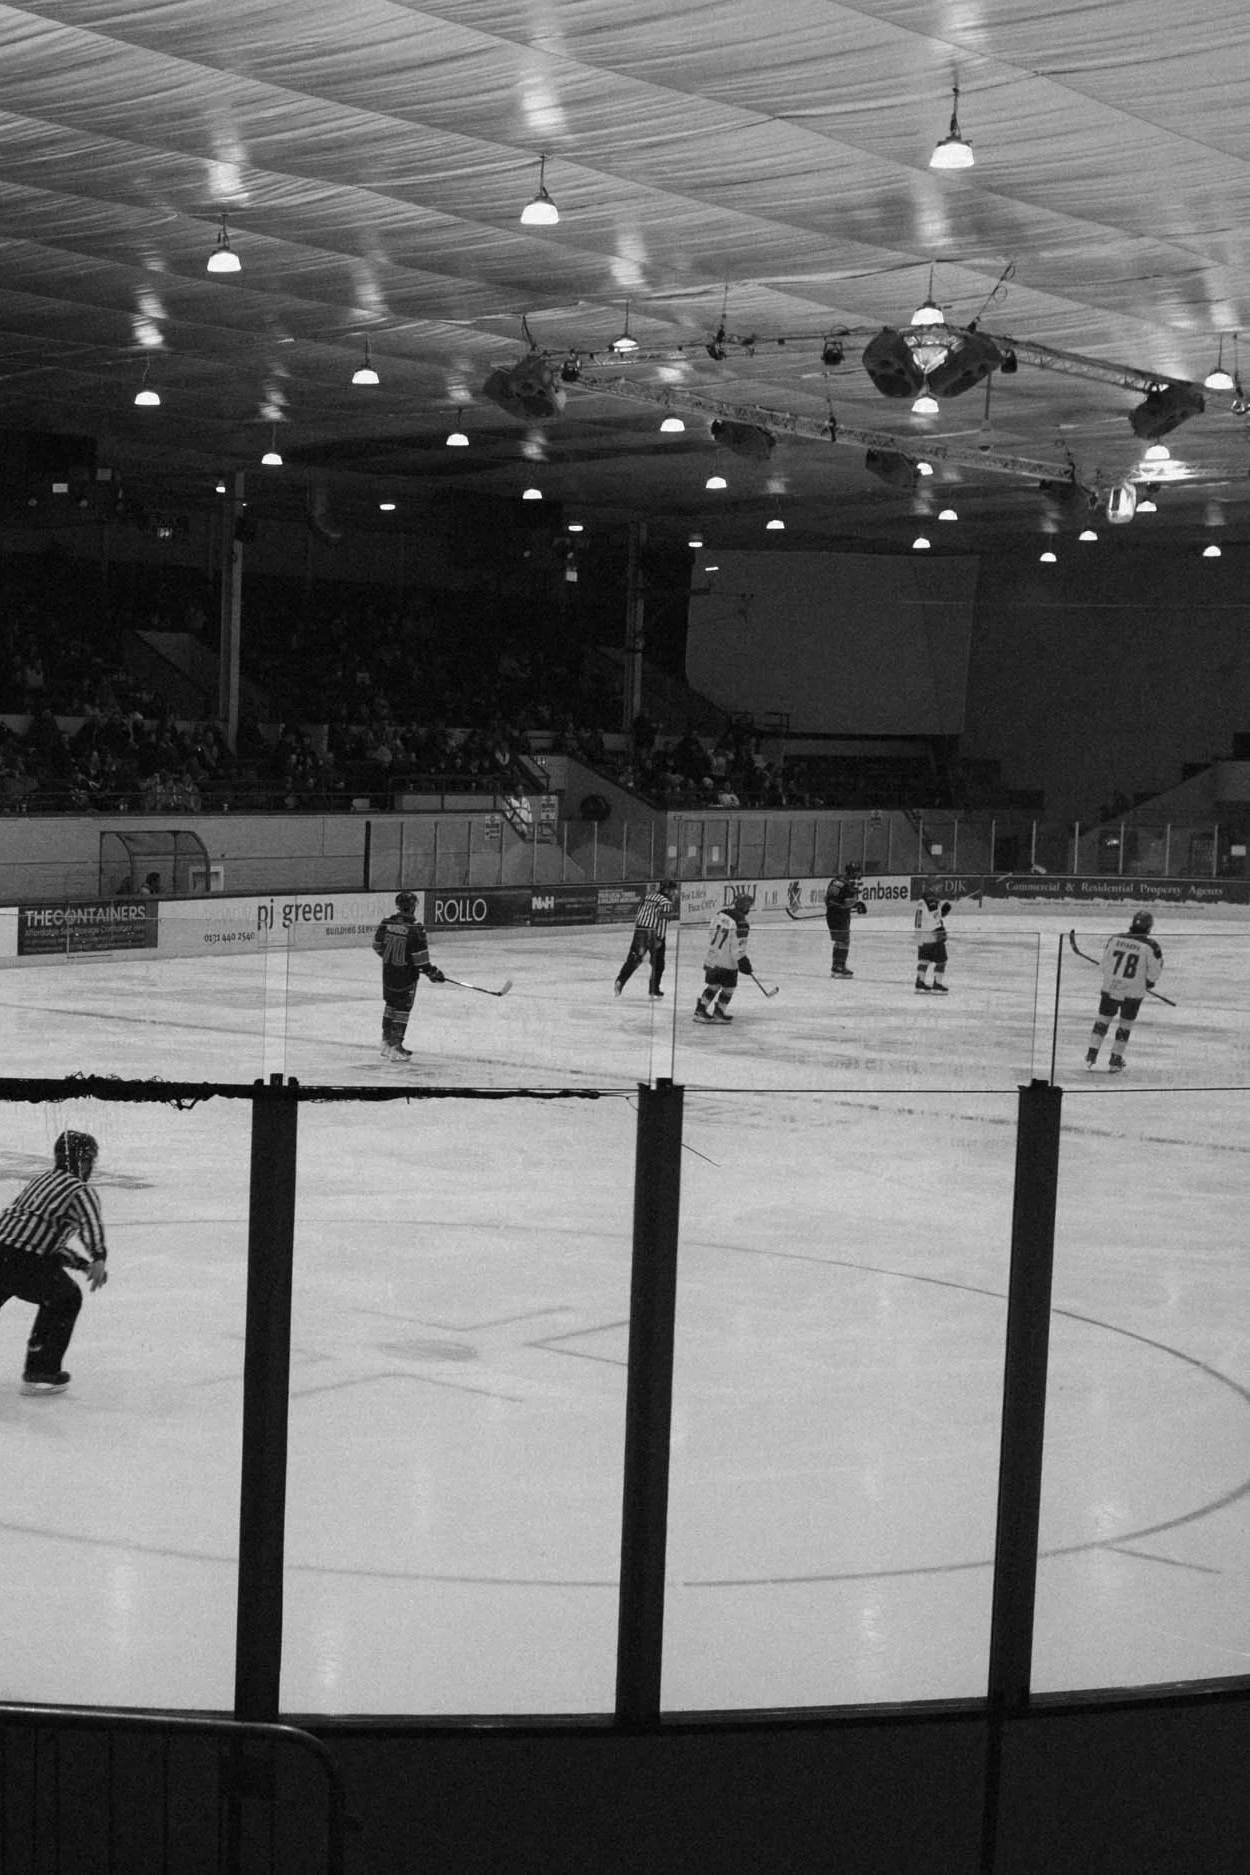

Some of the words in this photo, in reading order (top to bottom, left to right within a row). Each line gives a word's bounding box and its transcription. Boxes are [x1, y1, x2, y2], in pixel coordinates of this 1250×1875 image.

[1005, 881, 1060, 892] Commercial
[1081, 882, 1134, 893] Residential
[1140, 884, 1182, 897] Property
[1188, 886, 1224, 898] Agents
[257, 898, 274, 931] pj
[282, 902, 334, 929] green
[434, 898, 487, 922] ROLLO
[1112, 950, 1140, 979] 78
